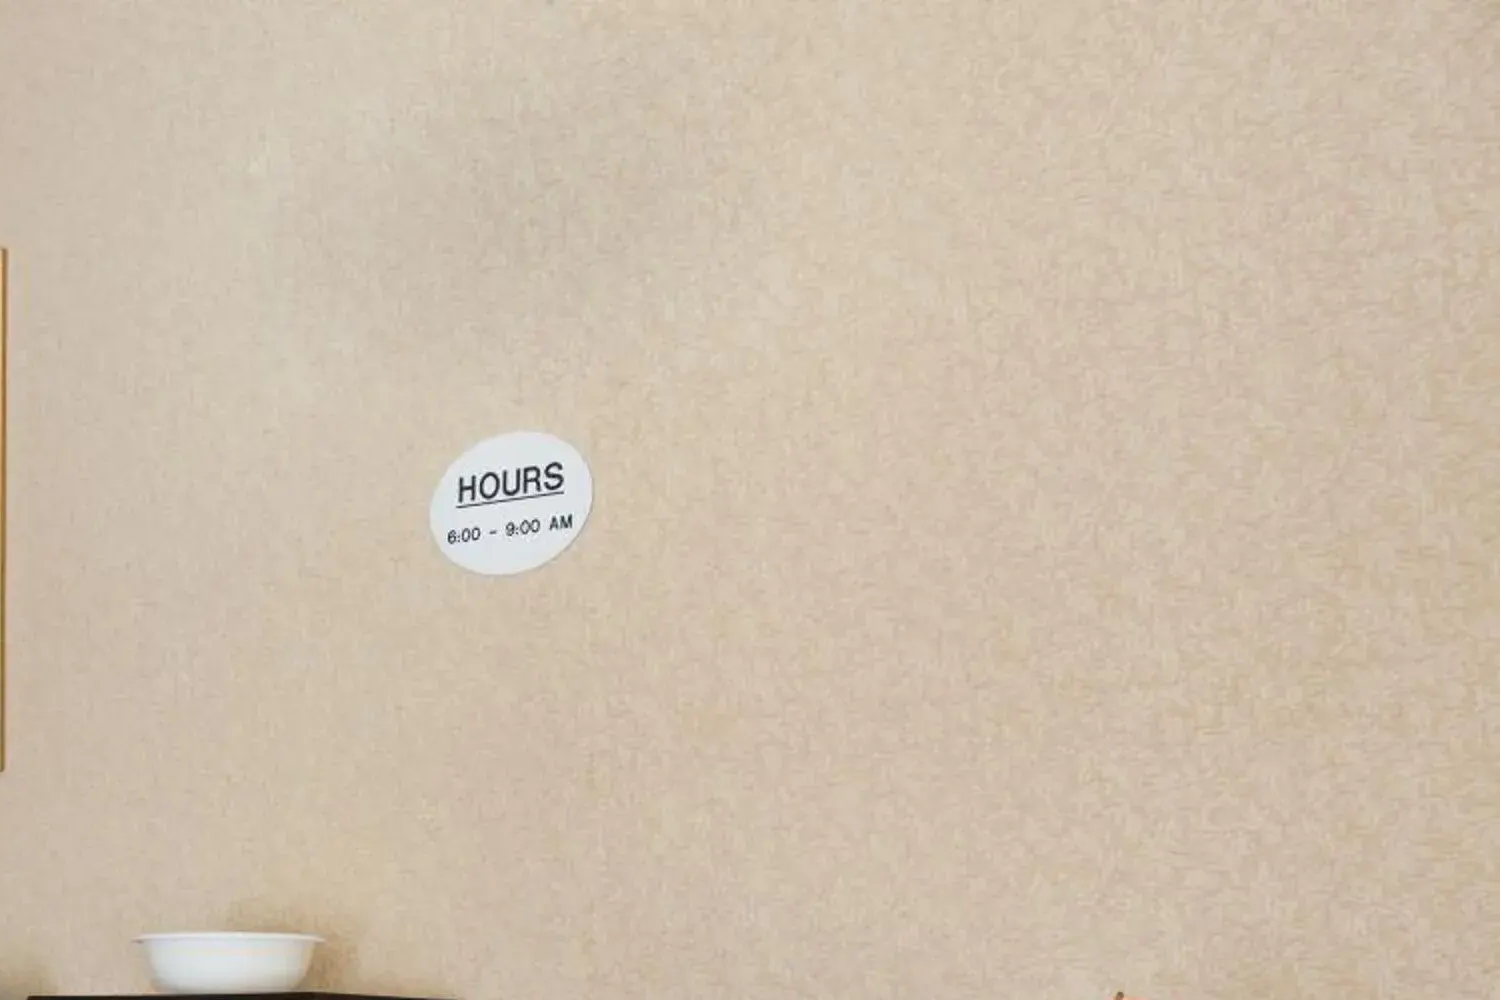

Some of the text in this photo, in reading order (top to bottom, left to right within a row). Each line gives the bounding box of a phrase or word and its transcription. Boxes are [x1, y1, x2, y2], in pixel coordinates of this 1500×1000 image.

[457, 461, 565, 503] HOURS
[447, 527, 481, 545] 6:00
[505, 519, 541, 537] 9:00
[549, 514, 573, 531] AM
